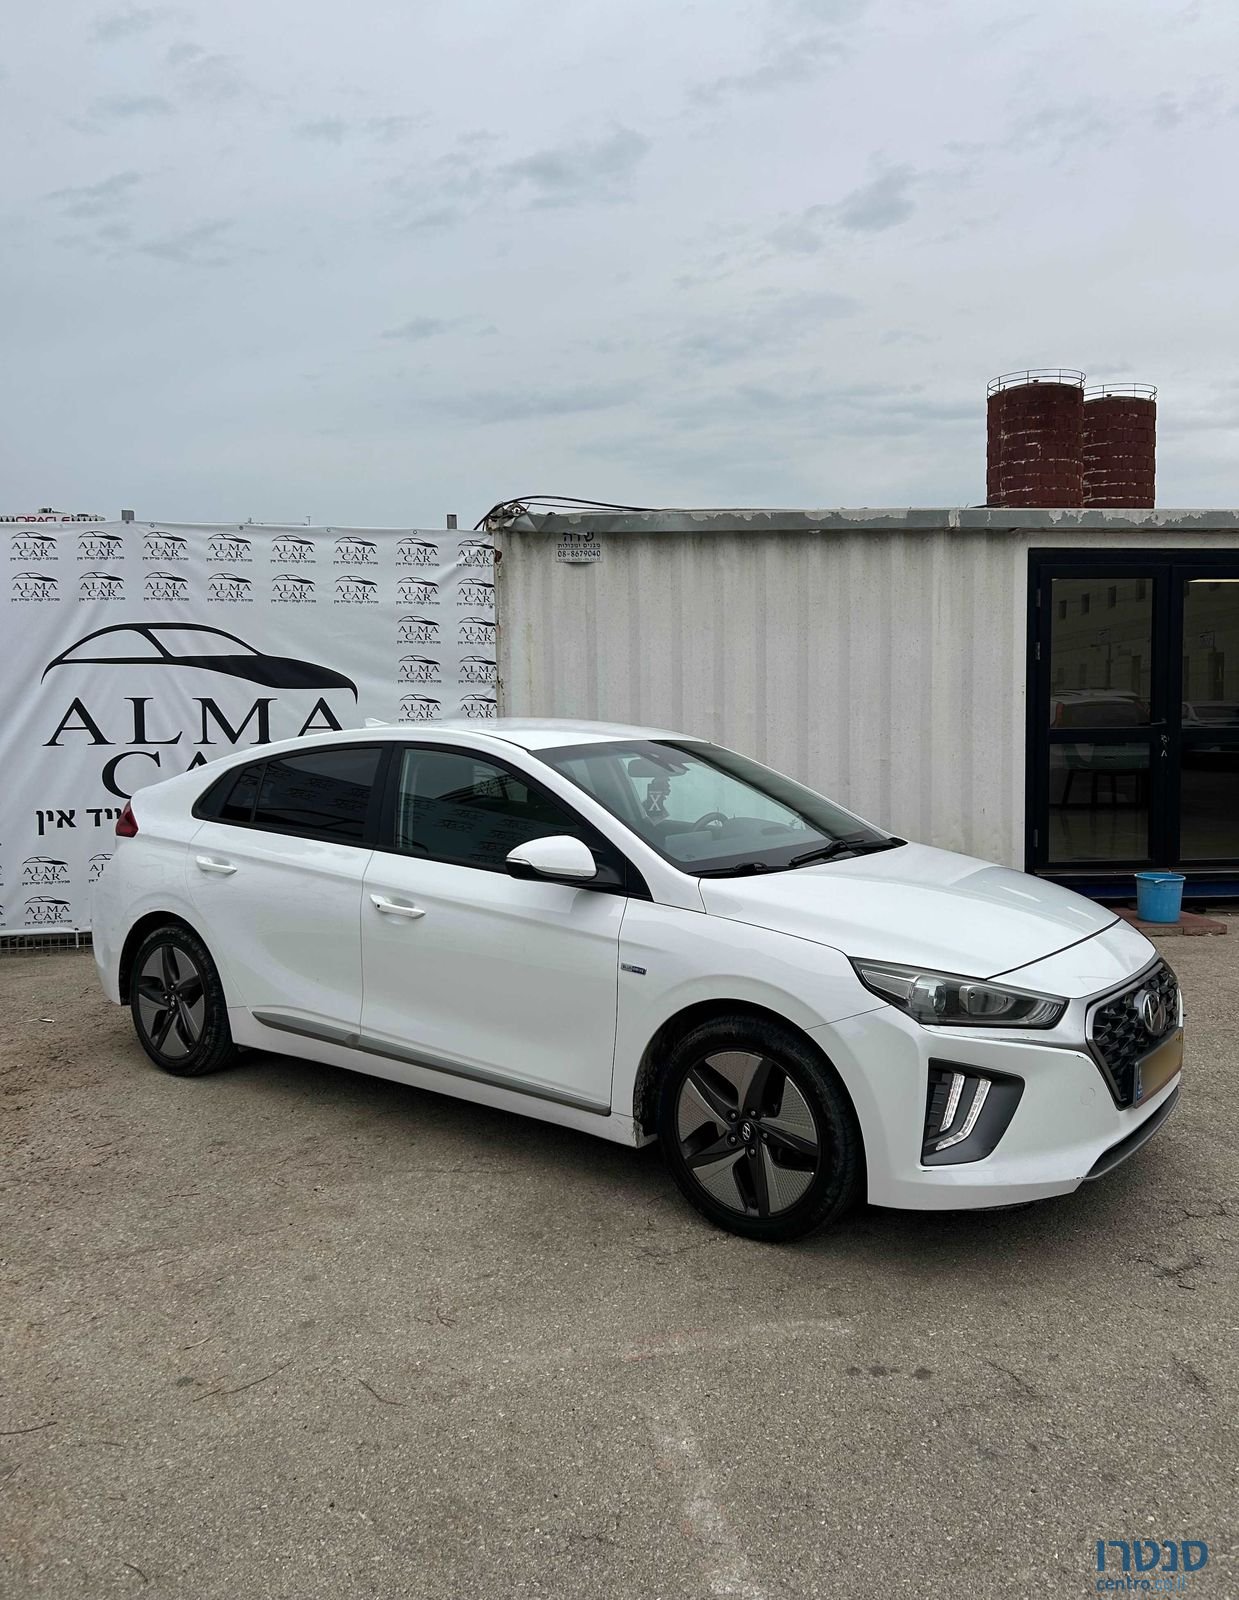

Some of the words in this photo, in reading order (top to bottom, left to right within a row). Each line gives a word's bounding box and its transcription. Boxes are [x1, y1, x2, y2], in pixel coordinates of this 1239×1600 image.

[78, 541, 122, 549] ALMA
[208, 543, 251, 551] ALMA
[335, 546, 376, 554] ALMA
[144, 582, 187, 590] ALMA
[208, 583, 251, 591] ALMA
[272, 584, 314, 592] ALMA
[336, 585, 377, 593] ALMA
[87, 589, 116, 597] CAR
[42, 697, 344, 746] ALMA
[36, 809, 77, 835] אין
[23, 865, 68, 874] ALMA
[31, 873, 60, 881] CAR
[25, 905, 70, 914] ALMA
